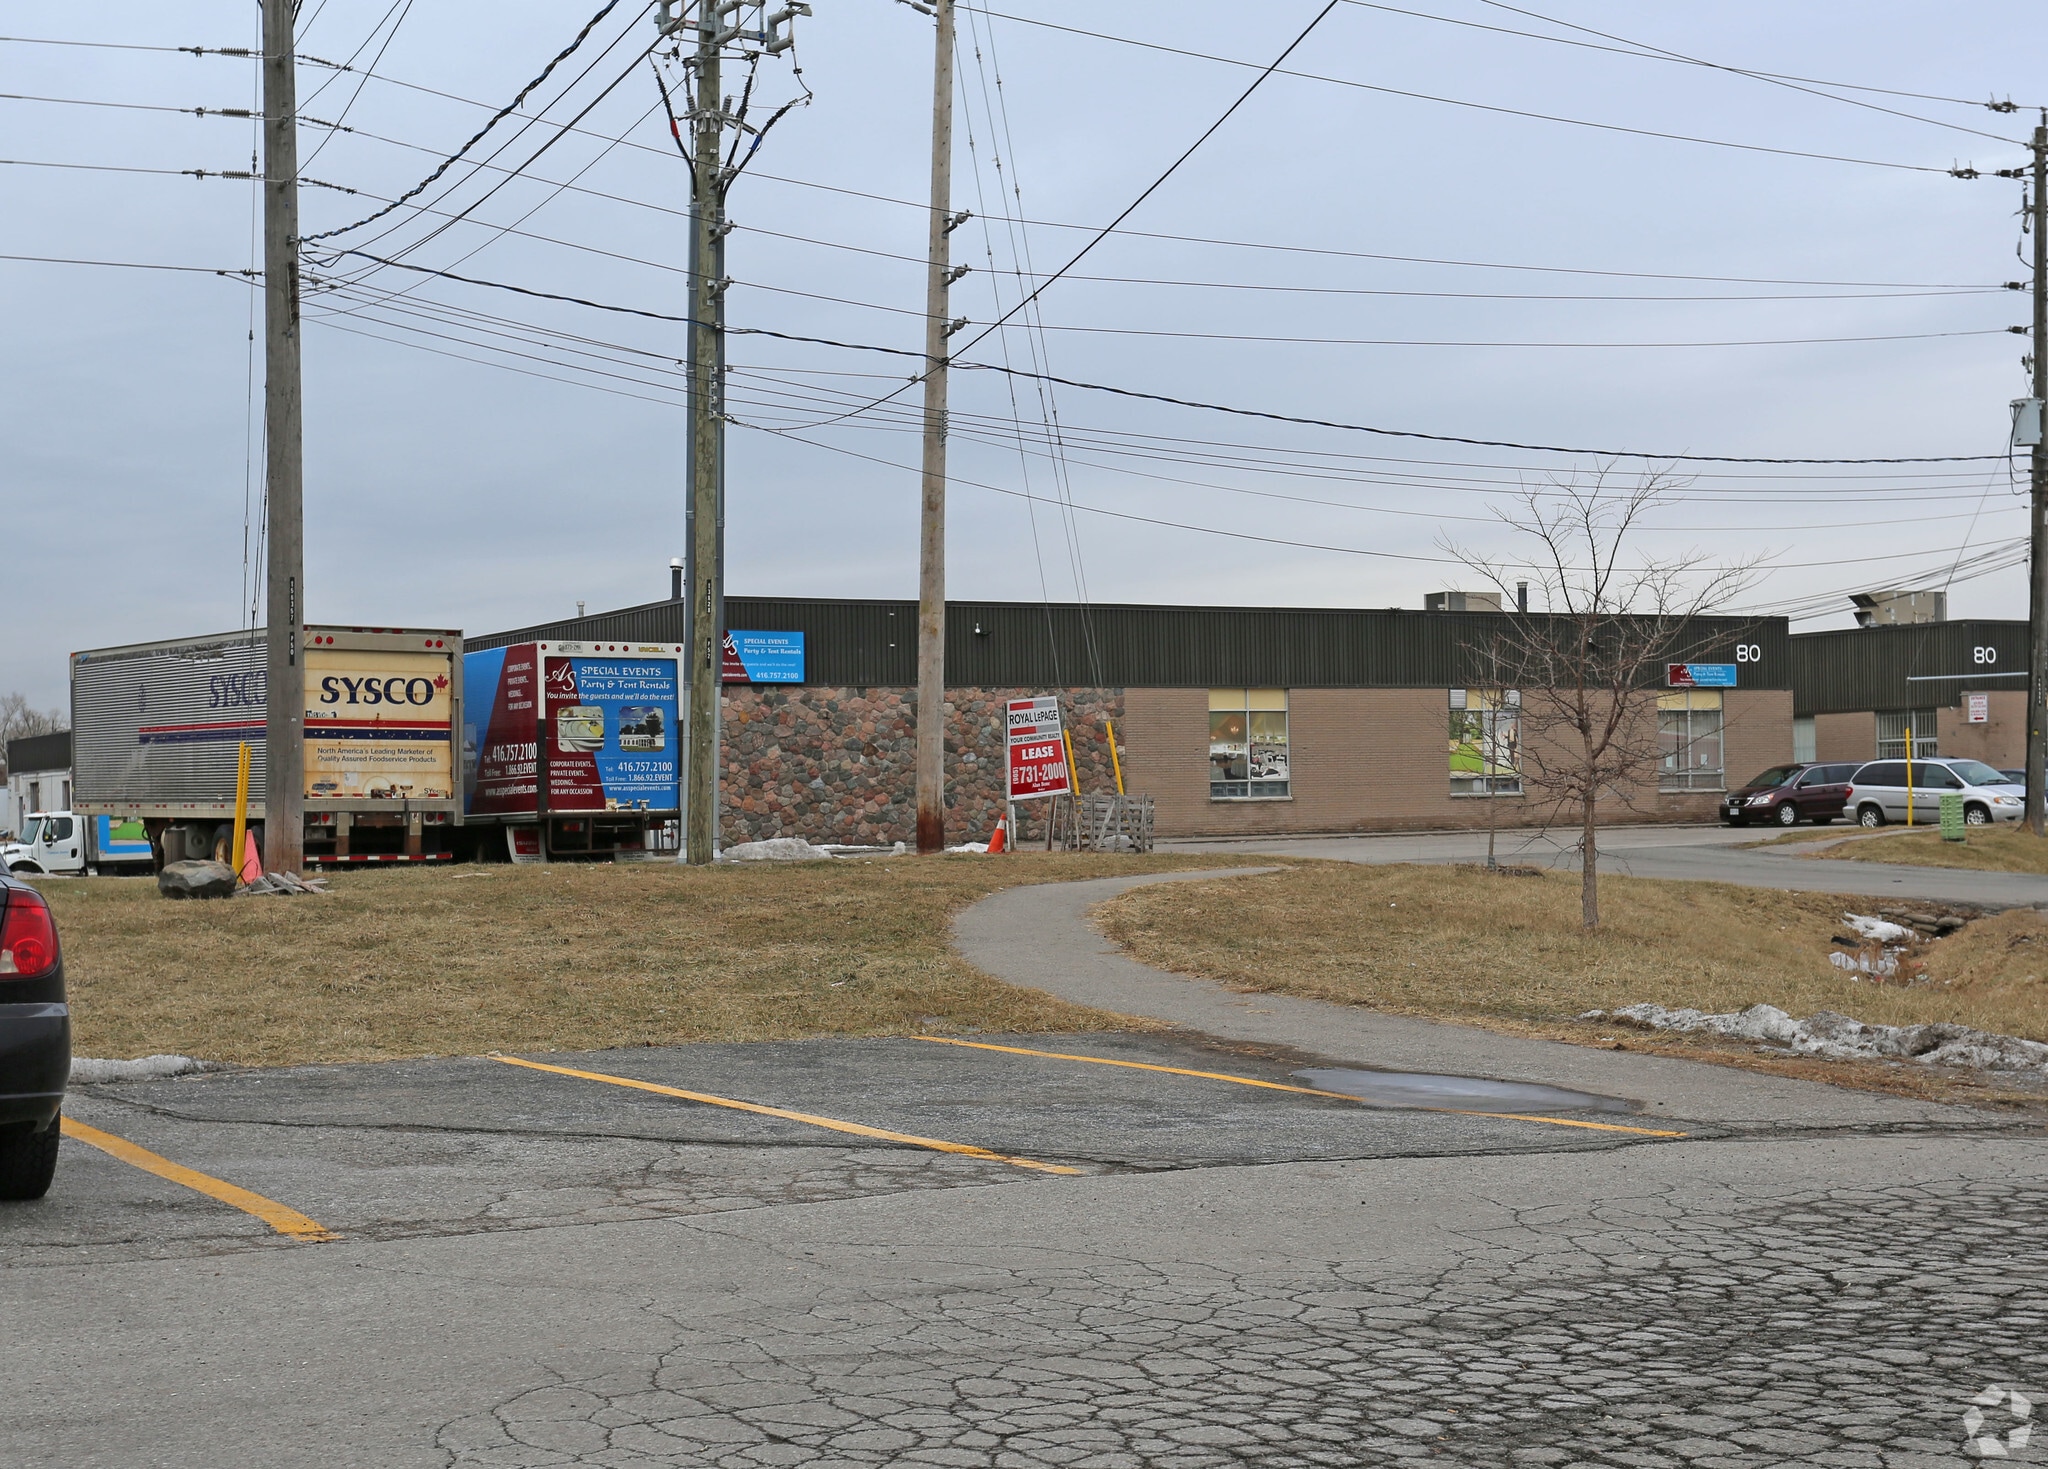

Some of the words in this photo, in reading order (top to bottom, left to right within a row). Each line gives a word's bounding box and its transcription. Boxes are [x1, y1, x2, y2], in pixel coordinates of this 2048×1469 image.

[1736, 644, 1760, 662] 80
[1974, 646, 1996, 664] 80
[582, 666, 620, 675] SPECIAL
[622, 667, 661, 676] EVENTS
[320, 676, 434, 706] SYSCO
[581, 680, 605, 690] Party
[607, 680, 615, 688] &
[618, 680, 637, 689] Tent
[640, 680, 670, 690] Rentals
[590, 692, 610, 700] guests
[624, 692, 640, 700] we'll
[660, 692, 674, 700] rest!
[1010, 712, 1033, 724] ROYAL
[492, 742, 538, 762] 416.757.2100
[1022, 746, 1054, 760] LEASE
[618, 762, 673, 772] 416.757.2100
[1019, 762, 1064, 784] 731-2000
